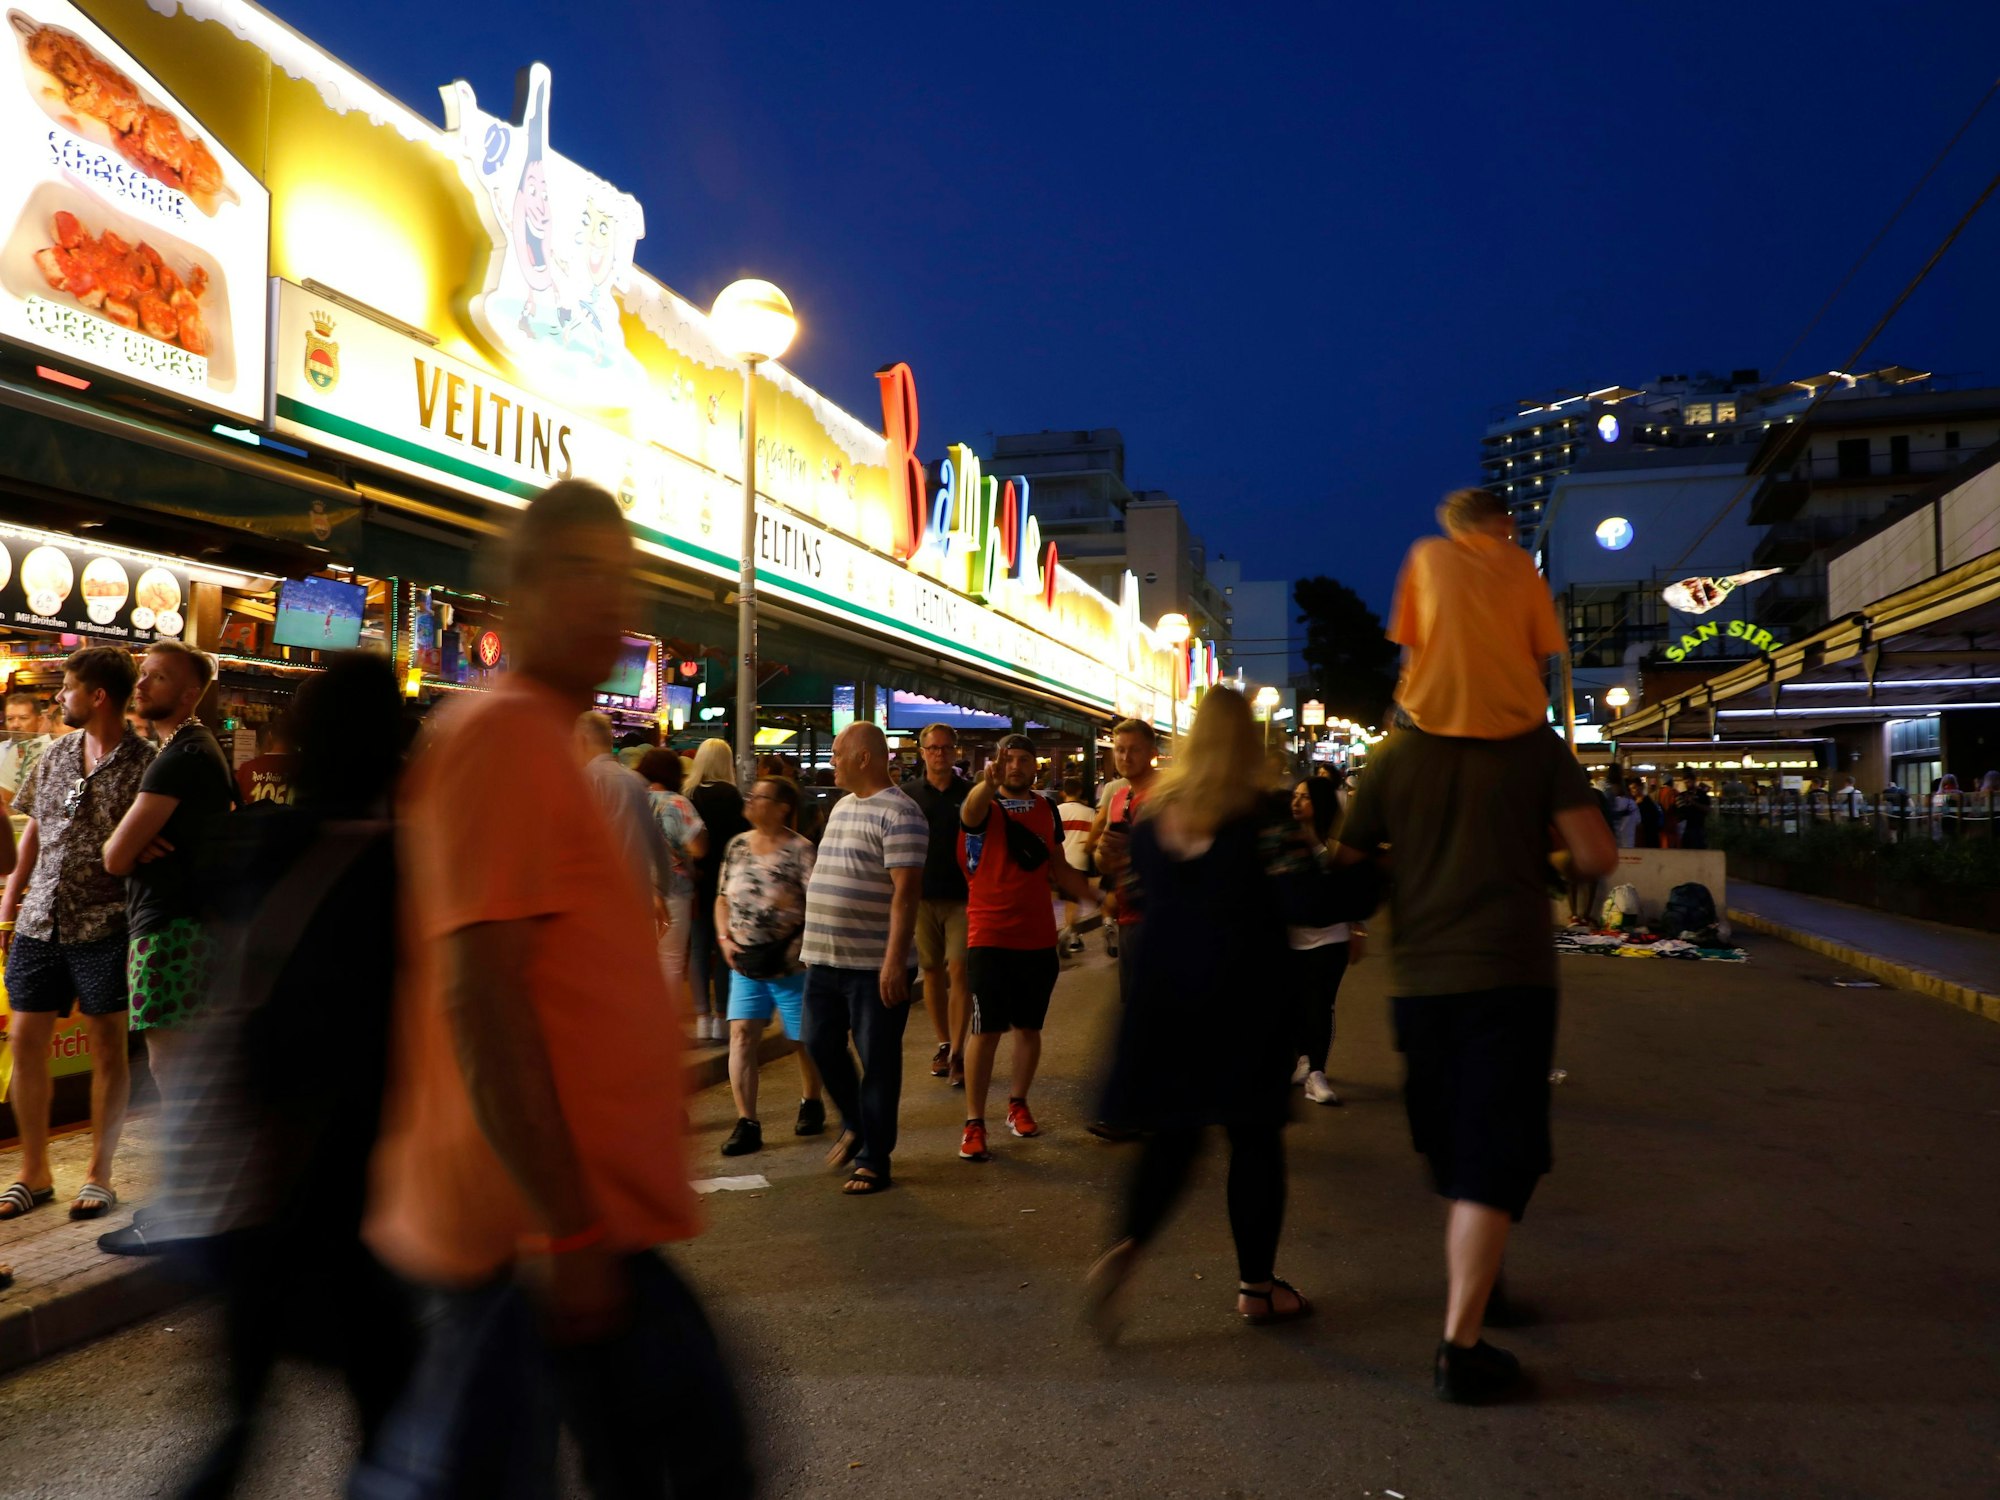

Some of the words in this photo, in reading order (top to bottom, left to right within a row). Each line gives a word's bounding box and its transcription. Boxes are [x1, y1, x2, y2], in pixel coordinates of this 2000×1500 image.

[413, 357, 573, 481] VELTINS
[1665, 620, 1719, 662] SAN
[52, 1027, 90, 1058] tch
